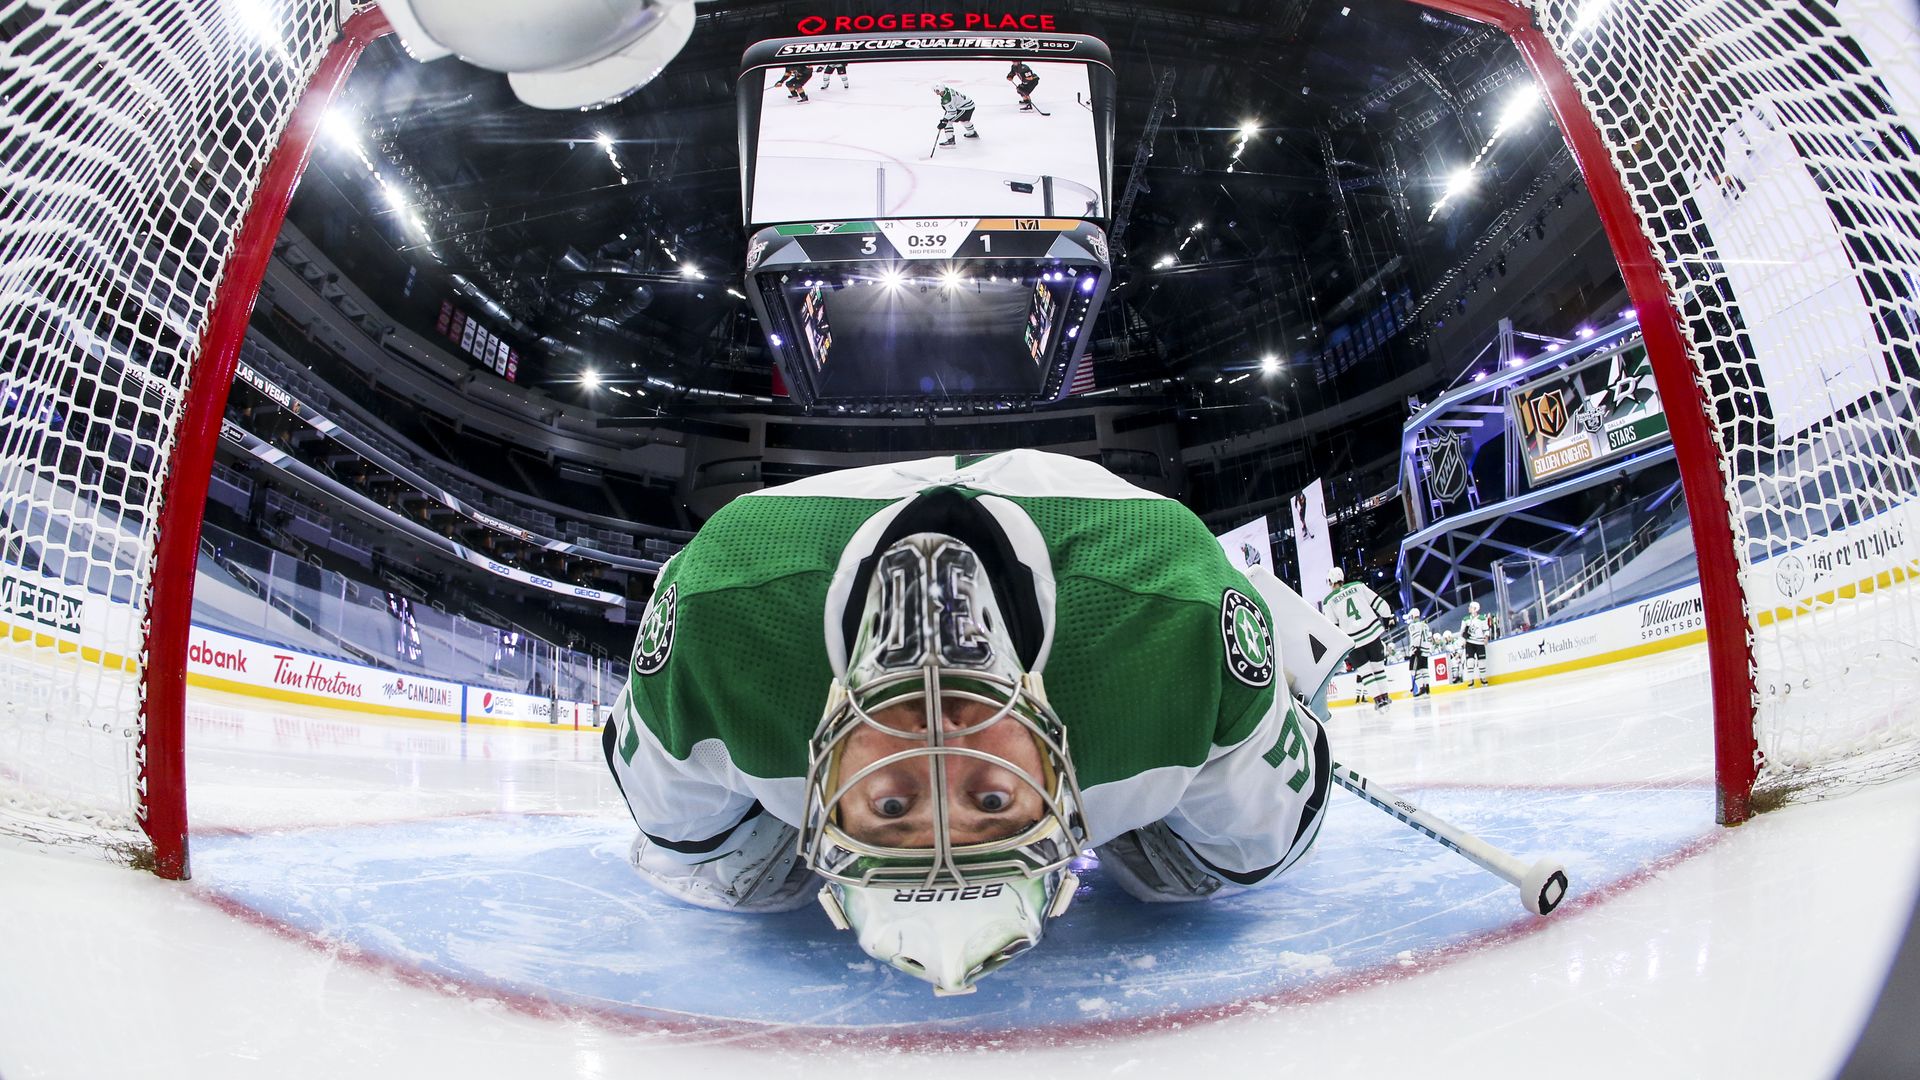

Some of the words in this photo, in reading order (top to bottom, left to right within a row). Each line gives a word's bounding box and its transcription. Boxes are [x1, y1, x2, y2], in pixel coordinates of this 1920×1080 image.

[835, 13, 954, 31] ROGERS
[965, 13, 1056, 30] PLACE
[782, 41, 865, 54] STANLEY
[864, 39, 903, 49] CUP
[905, 38, 1016, 49] QUALIFIERS
[860, 236, 877, 255] 3
[908, 234, 947, 247] 0:39
[979, 234, 991, 253] 1
[234, 362, 254, 382] LAS
[264, 381, 291, 407] VEGAS
[1609, 425, 1636, 448] STARS
[1534, 452, 1561, 474] GOLDEN
[1560, 442, 1590, 466] KNIGHTS
[1438, 449, 1456, 492] NHL
[530, 575, 553, 588] GEICO
[574, 587, 600, 599] GEICO
[1346, 597, 1362, 621] 4
[1639, 599, 1693, 629] William
[1517, 647, 1538, 660] Valley
[1548, 638, 1573, 654] Health
[273, 654, 302, 688] Tim
[304, 660, 362, 698] Hortons
[407, 683, 447, 706] CANADIAN
[894, 882, 1004, 903] BAUER
